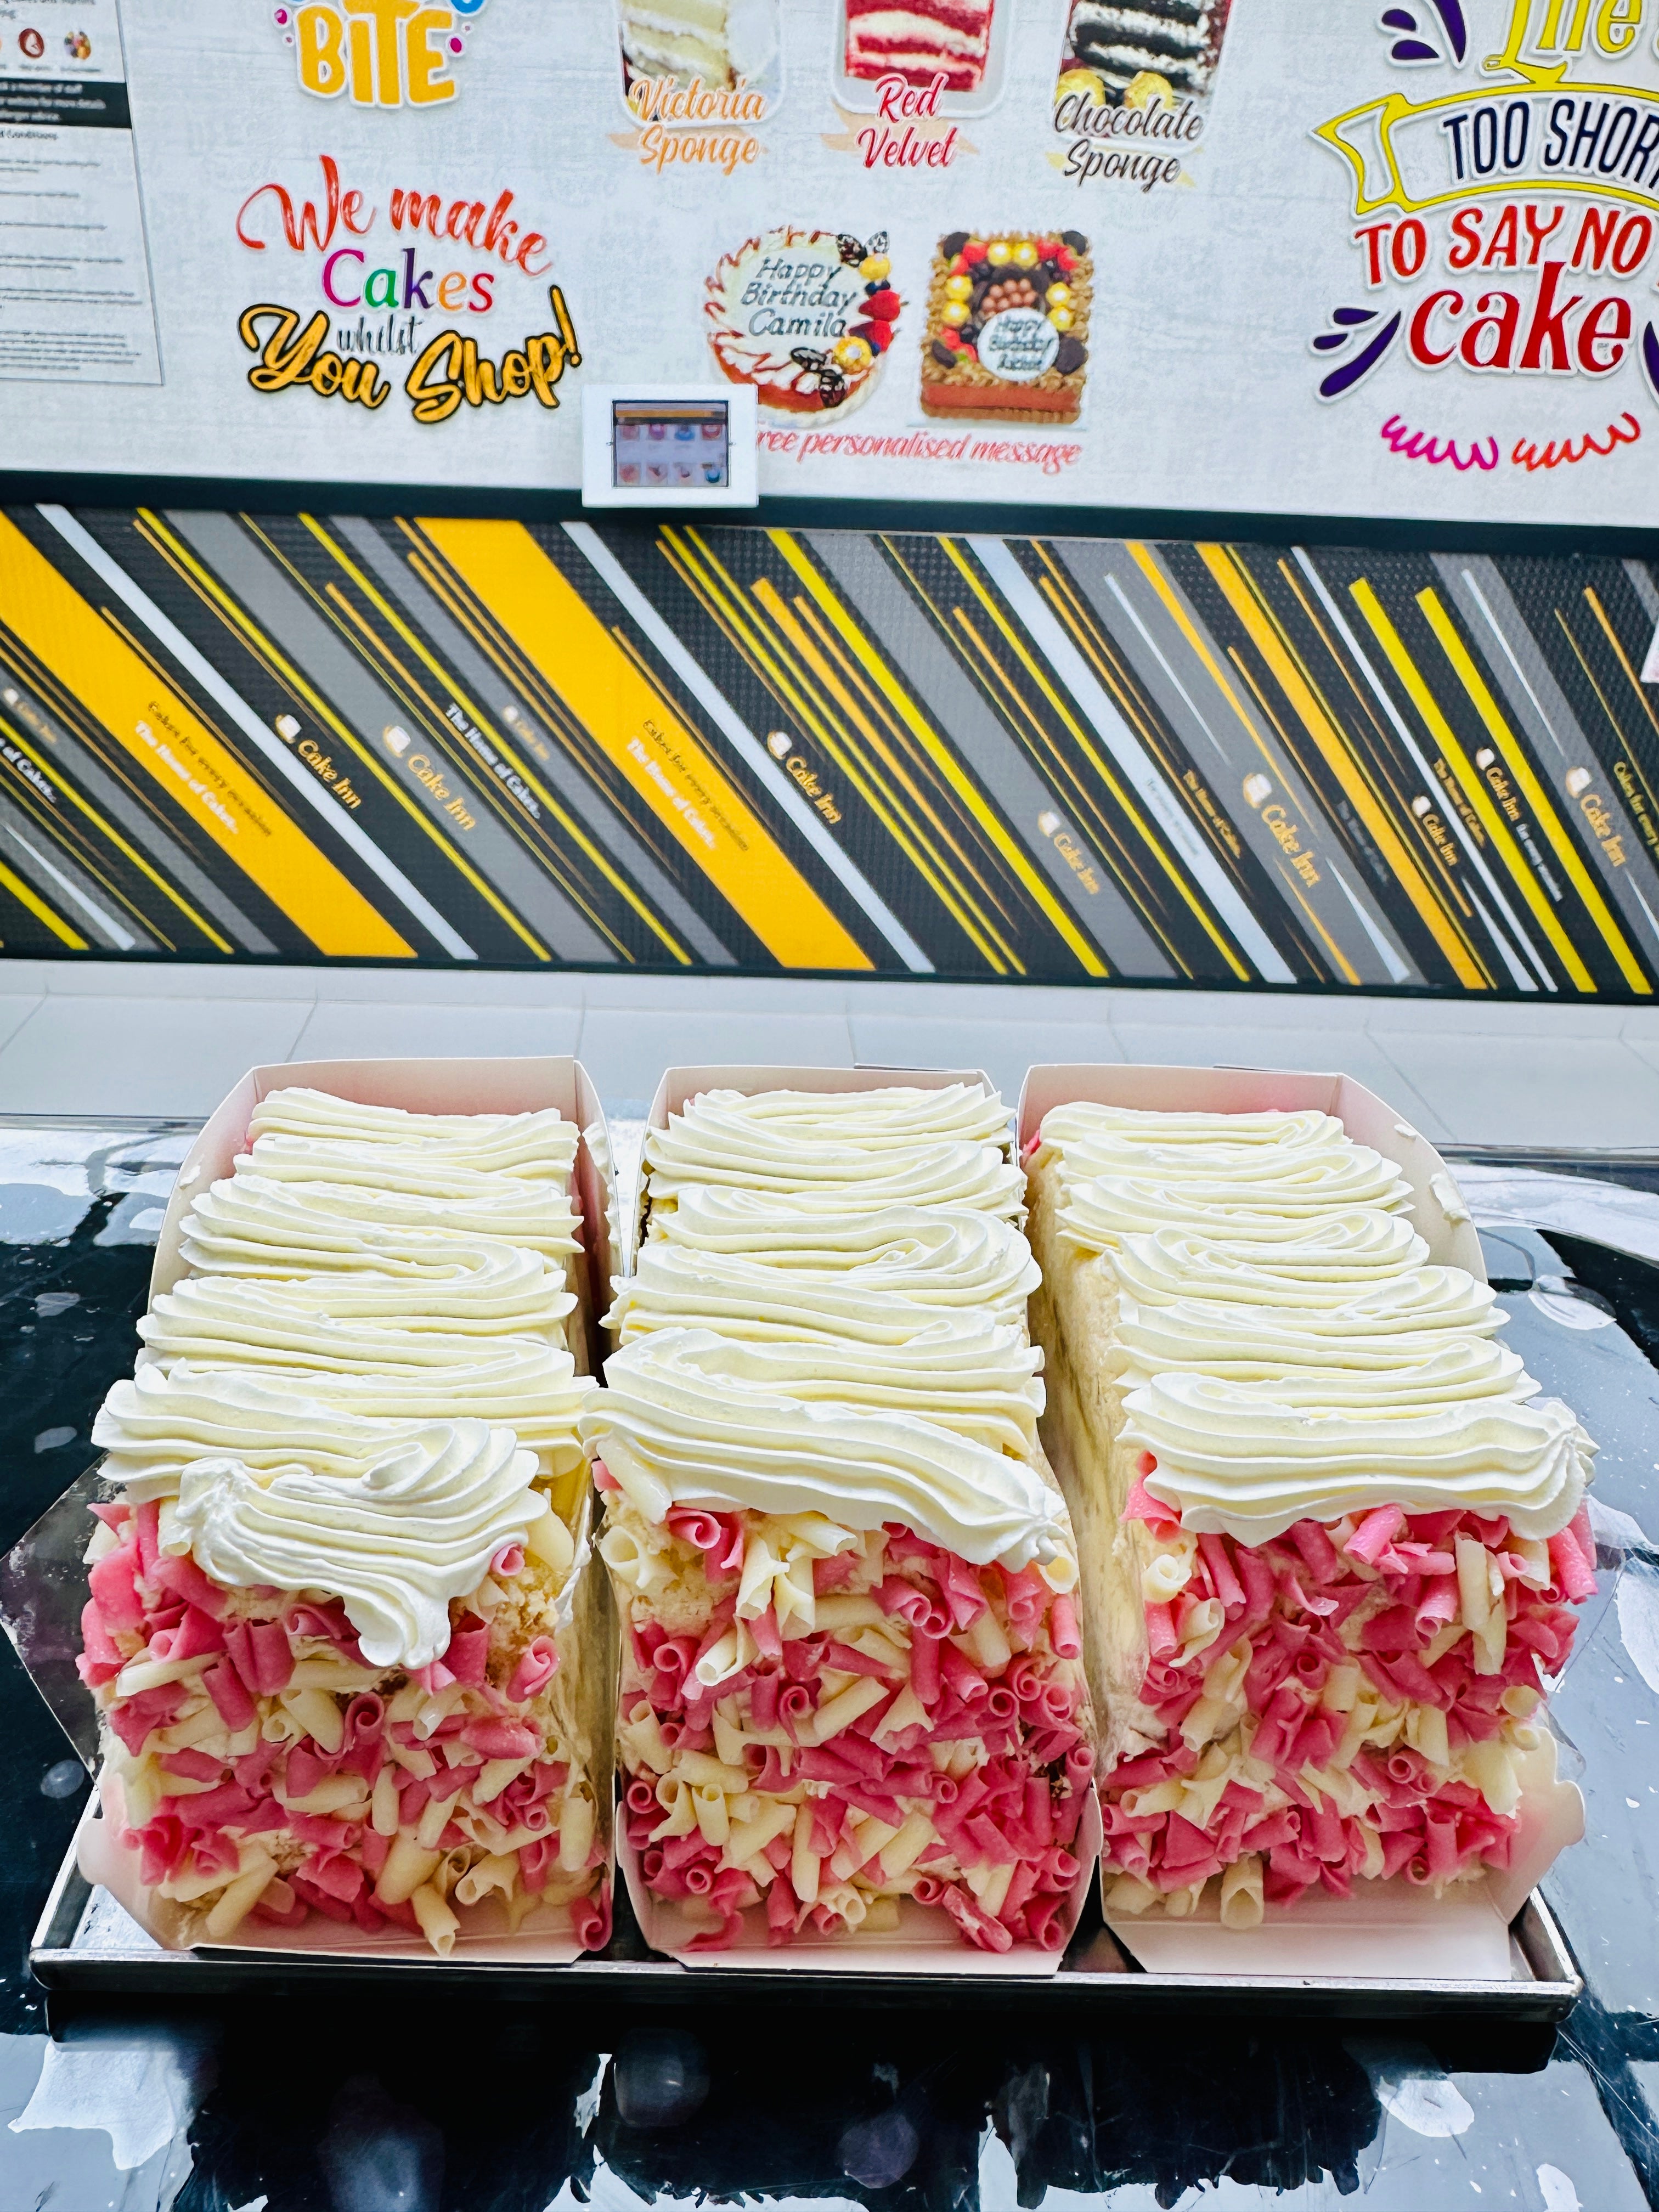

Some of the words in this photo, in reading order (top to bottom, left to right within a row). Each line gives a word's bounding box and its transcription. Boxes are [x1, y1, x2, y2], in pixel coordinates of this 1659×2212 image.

[297, 0, 455, 104] BITE
[631, 76, 765, 121] Victoria
[876, 74, 947, 123] Red
[1053, 93, 1204, 141] Chocolate
[640, 125, 759, 176] Sponge
[857, 127, 958, 169] Velvet
[1064, 140, 1181, 193] Sponge
[1444, 101, 1530, 179] TOO
[1544, 99, 1659, 189] SHOR
[236, 155, 377, 252] We
[390, 189, 553, 276] make
[1355, 219, 1426, 285] TO
[1449, 206, 1564, 268] SAY
[1571, 207, 1652, 273] NO
[322, 247, 495, 313] Cakes
[741, 281, 857, 315] Birthday
[756, 257, 842, 289] Happy
[337, 314, 425, 356] whilst
[749, 308, 846, 337] Camila
[1410, 261, 1631, 373] cake
[238, 303, 390, 409] You
[404, 285, 582, 424] Shop!
[757, 430, 800, 453] ree
[796, 431, 972, 464] personalised
[969, 439, 1083, 475] message
[445, 702, 469, 731] The
[3, 747, 23, 763] of
[298, 740, 338, 782] Cake
[332, 778, 362, 810] Inn
[1614, 761, 1635, 797] Cakes
[408, 755, 450, 800] Cake
[444, 797, 476, 831] Inn
[786, 756, 822, 797] Cake
[815, 792, 842, 824] Inn
[1486, 767, 1509, 799] Cake
[1502, 797, 1521, 821] Inn
[1262, 804, 1299, 854] Cake
[1290, 851, 1320, 888] Inn
[1423, 814, 1447, 847] Cake
[1440, 843, 1458, 866] Inn
[1580, 794, 1611, 839] Cake
[1601, 835, 1626, 867] Inn
